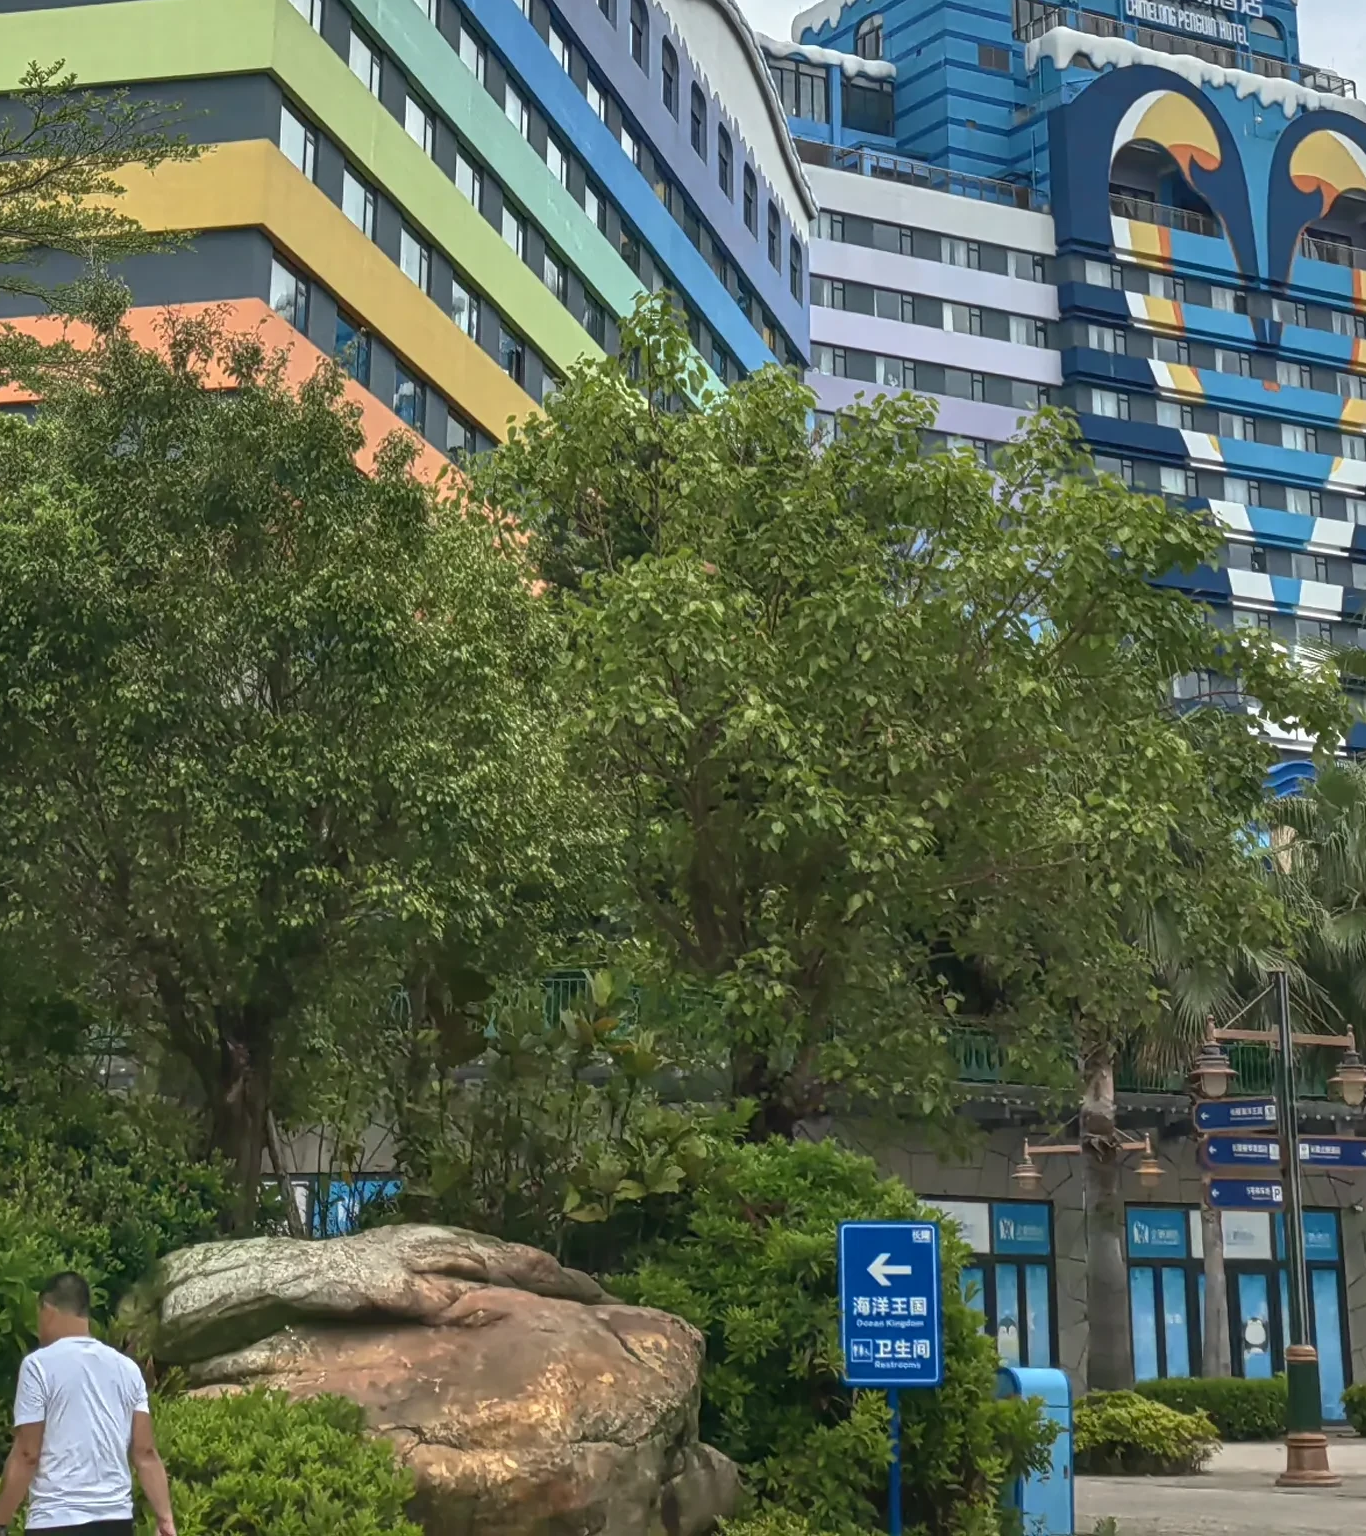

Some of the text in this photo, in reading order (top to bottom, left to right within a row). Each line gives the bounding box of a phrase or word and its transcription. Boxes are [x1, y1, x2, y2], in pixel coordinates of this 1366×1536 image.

[1178, 9, 1217, 38] PENGUIN
[1219, 20, 1250, 46] HOTEL
[853, 1296, 927, 1316] 海洋王国
[856, 1318, 924, 1329] Ocean Kingdom
[875, 1339, 930, 1358] 卫生间
[874, 1361, 921, 1369] Restrooms
